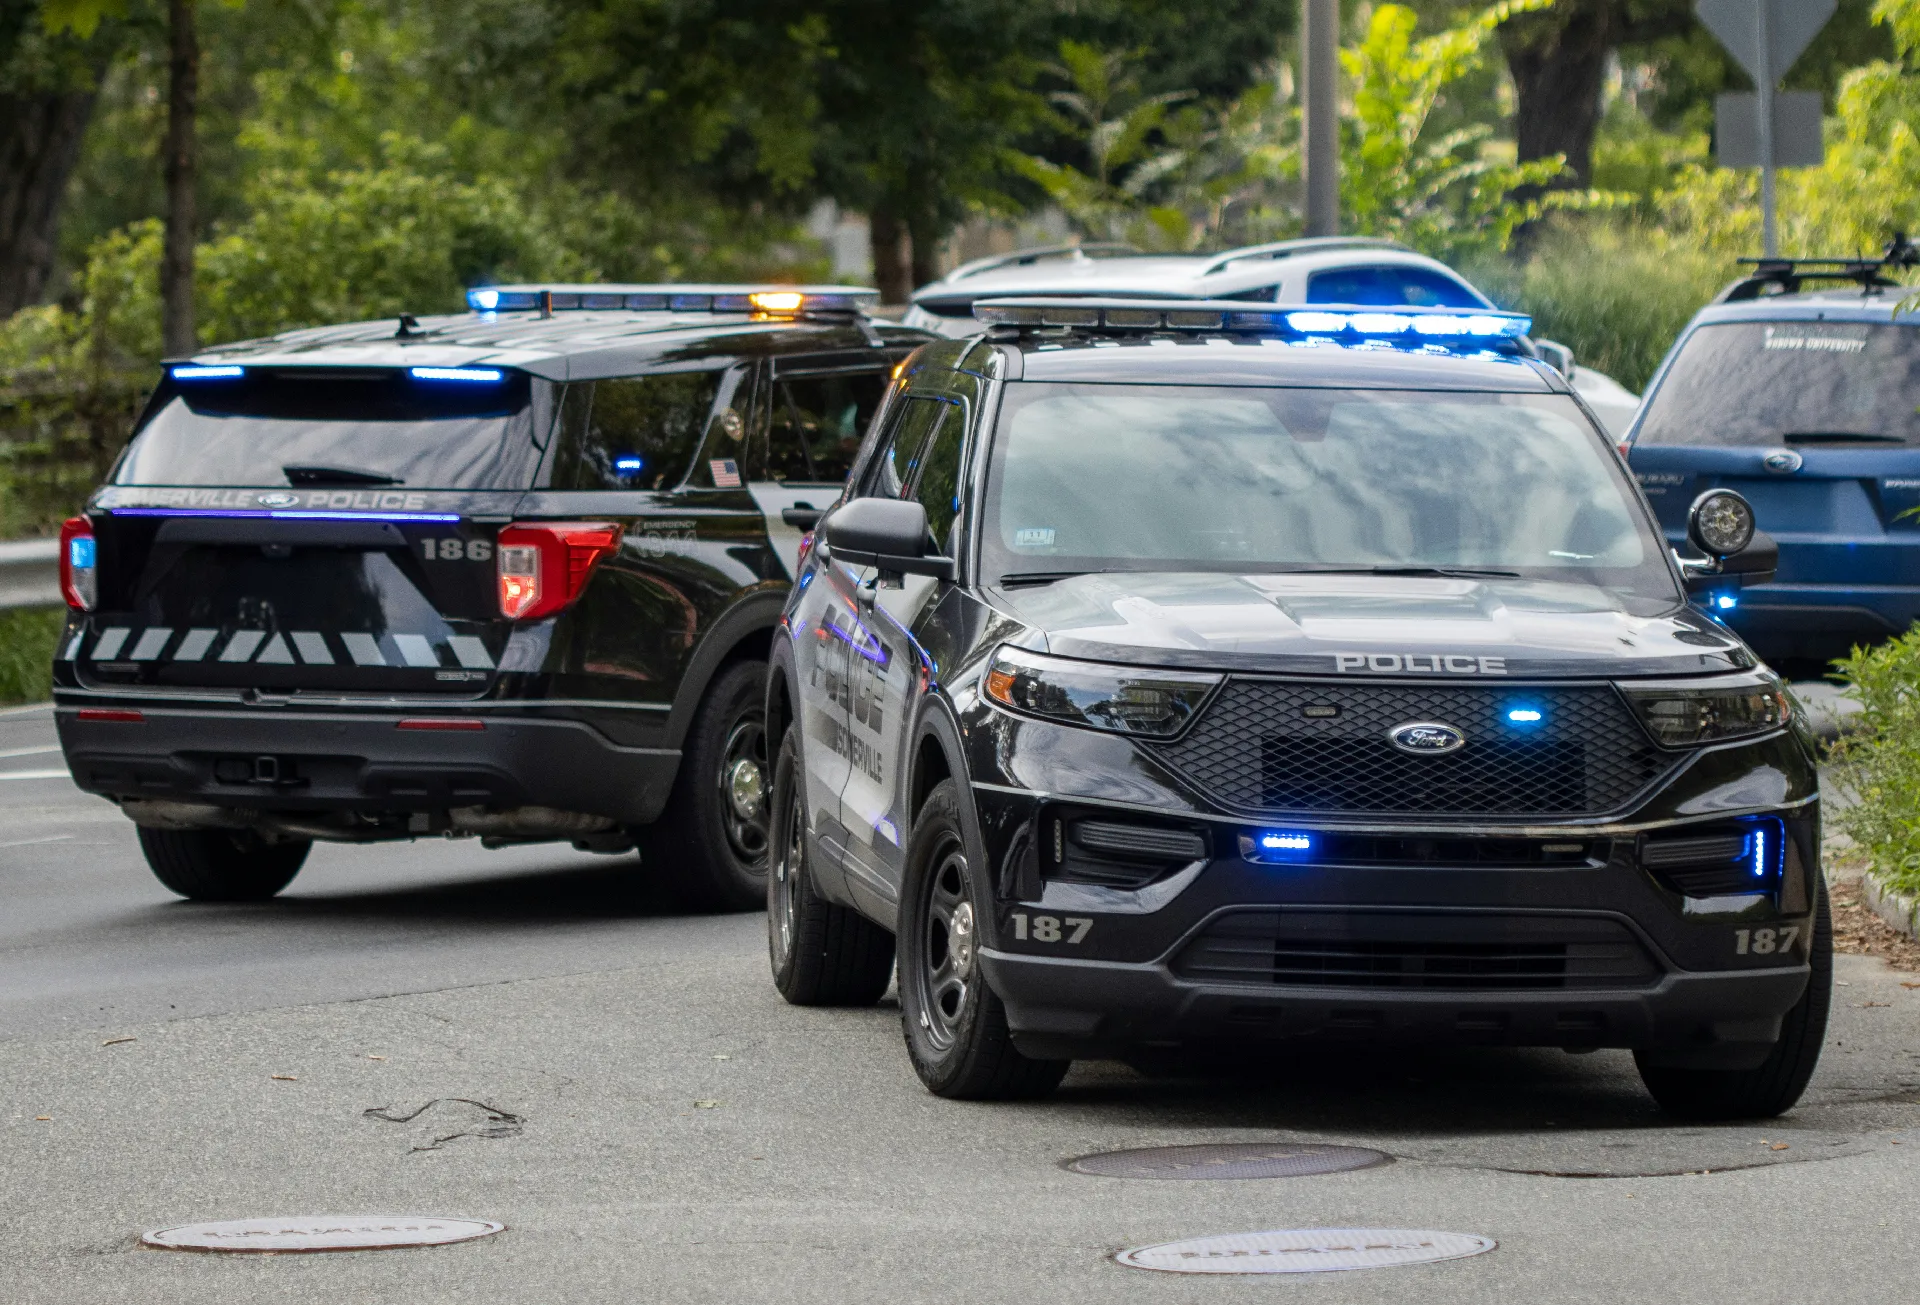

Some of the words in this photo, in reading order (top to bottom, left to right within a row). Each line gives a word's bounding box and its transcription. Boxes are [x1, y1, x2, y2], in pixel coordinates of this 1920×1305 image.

[306, 491, 427, 511] POLICE
[420, 538, 492, 561] 186
[1335, 654, 1508, 675] POLICE
[1406, 728, 1447, 748] Ford
[1011, 913, 1094, 944] 187
[1735, 926, 1800, 955] 187
